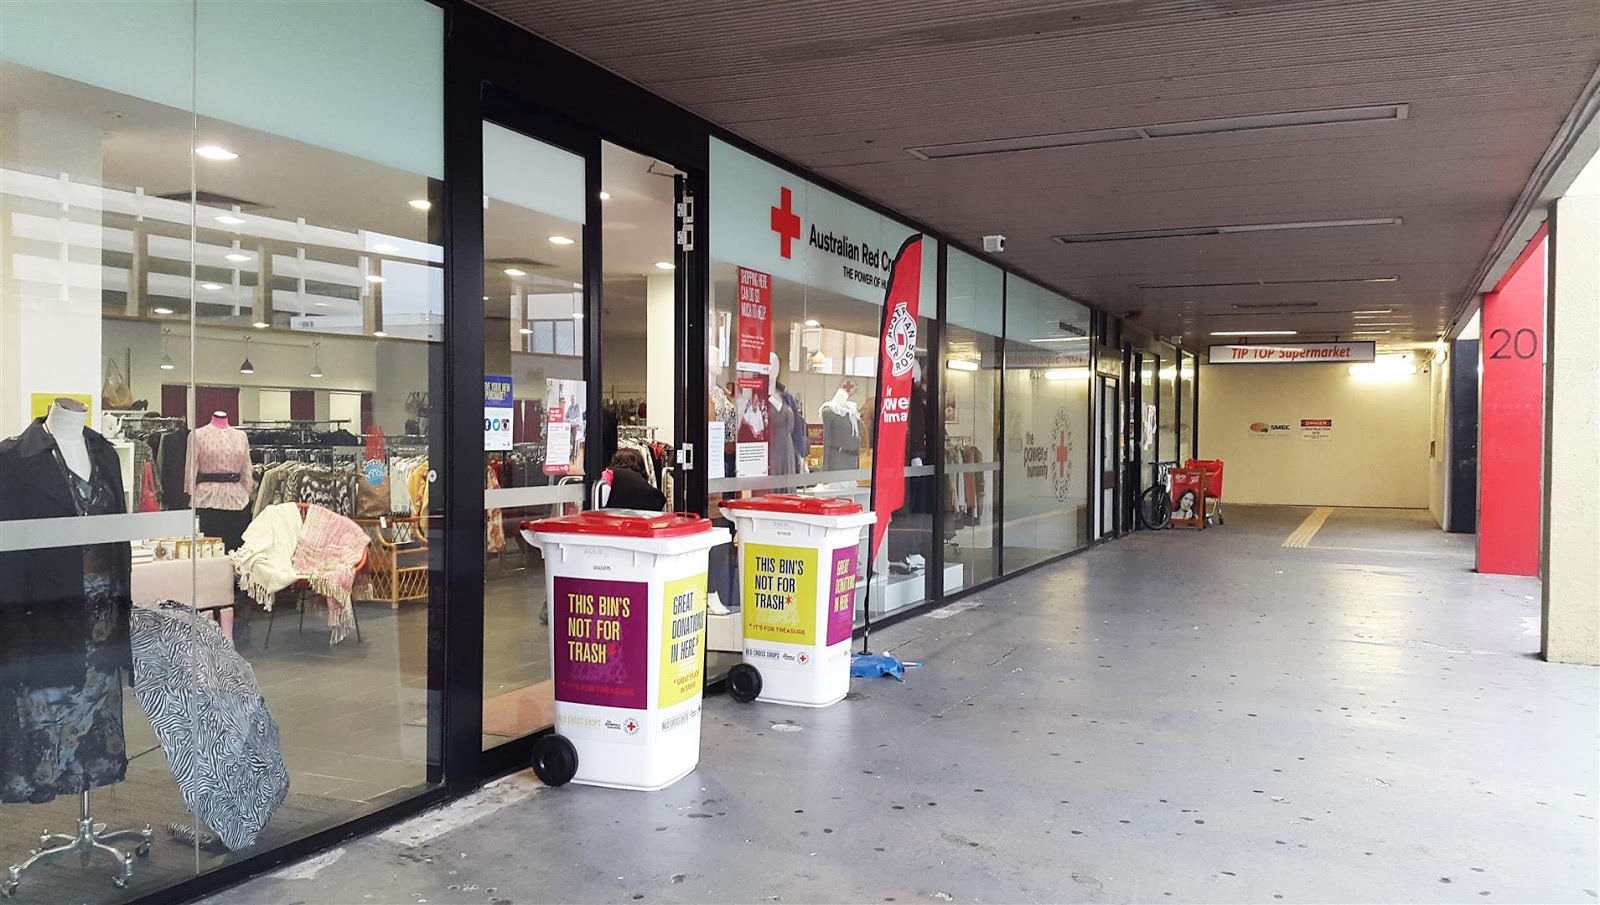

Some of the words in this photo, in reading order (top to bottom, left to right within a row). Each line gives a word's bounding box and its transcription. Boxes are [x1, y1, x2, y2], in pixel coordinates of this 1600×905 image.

[809, 224, 859, 262] Australian
[862, 243, 880, 267] Red
[843, 266, 853, 280] THE
[854, 270, 874, 285] POWER
[873, 276, 881, 288] OF
[1489, 327, 1538, 360] 20
[1231, 348, 1249, 360] TIP
[1253, 348, 1275, 359] TOP
[1279, 345, 1352, 363] Supermarket
[1026, 430, 1034, 445] the
[1024, 447, 1043, 467] power
[1026, 463, 1049, 480] humanity
[755, 556, 776, 573] THIS
[779, 558, 804, 575] BIN'S
[837, 558, 850, 576] GREAT
[755, 575, 774, 591] NOT
[777, 576, 796, 593] FOR
[568, 593, 594, 616] THIS
[599, 596, 631, 618] BIN'S
[673, 592, 694, 616] GREAT
[568, 617, 592, 638] NOT
[596, 619, 620, 641] FOR
[671, 610, 704, 640] DONATIONS
[776, 627, 806, 635] TREASURE
[671, 643, 679, 664] IN
